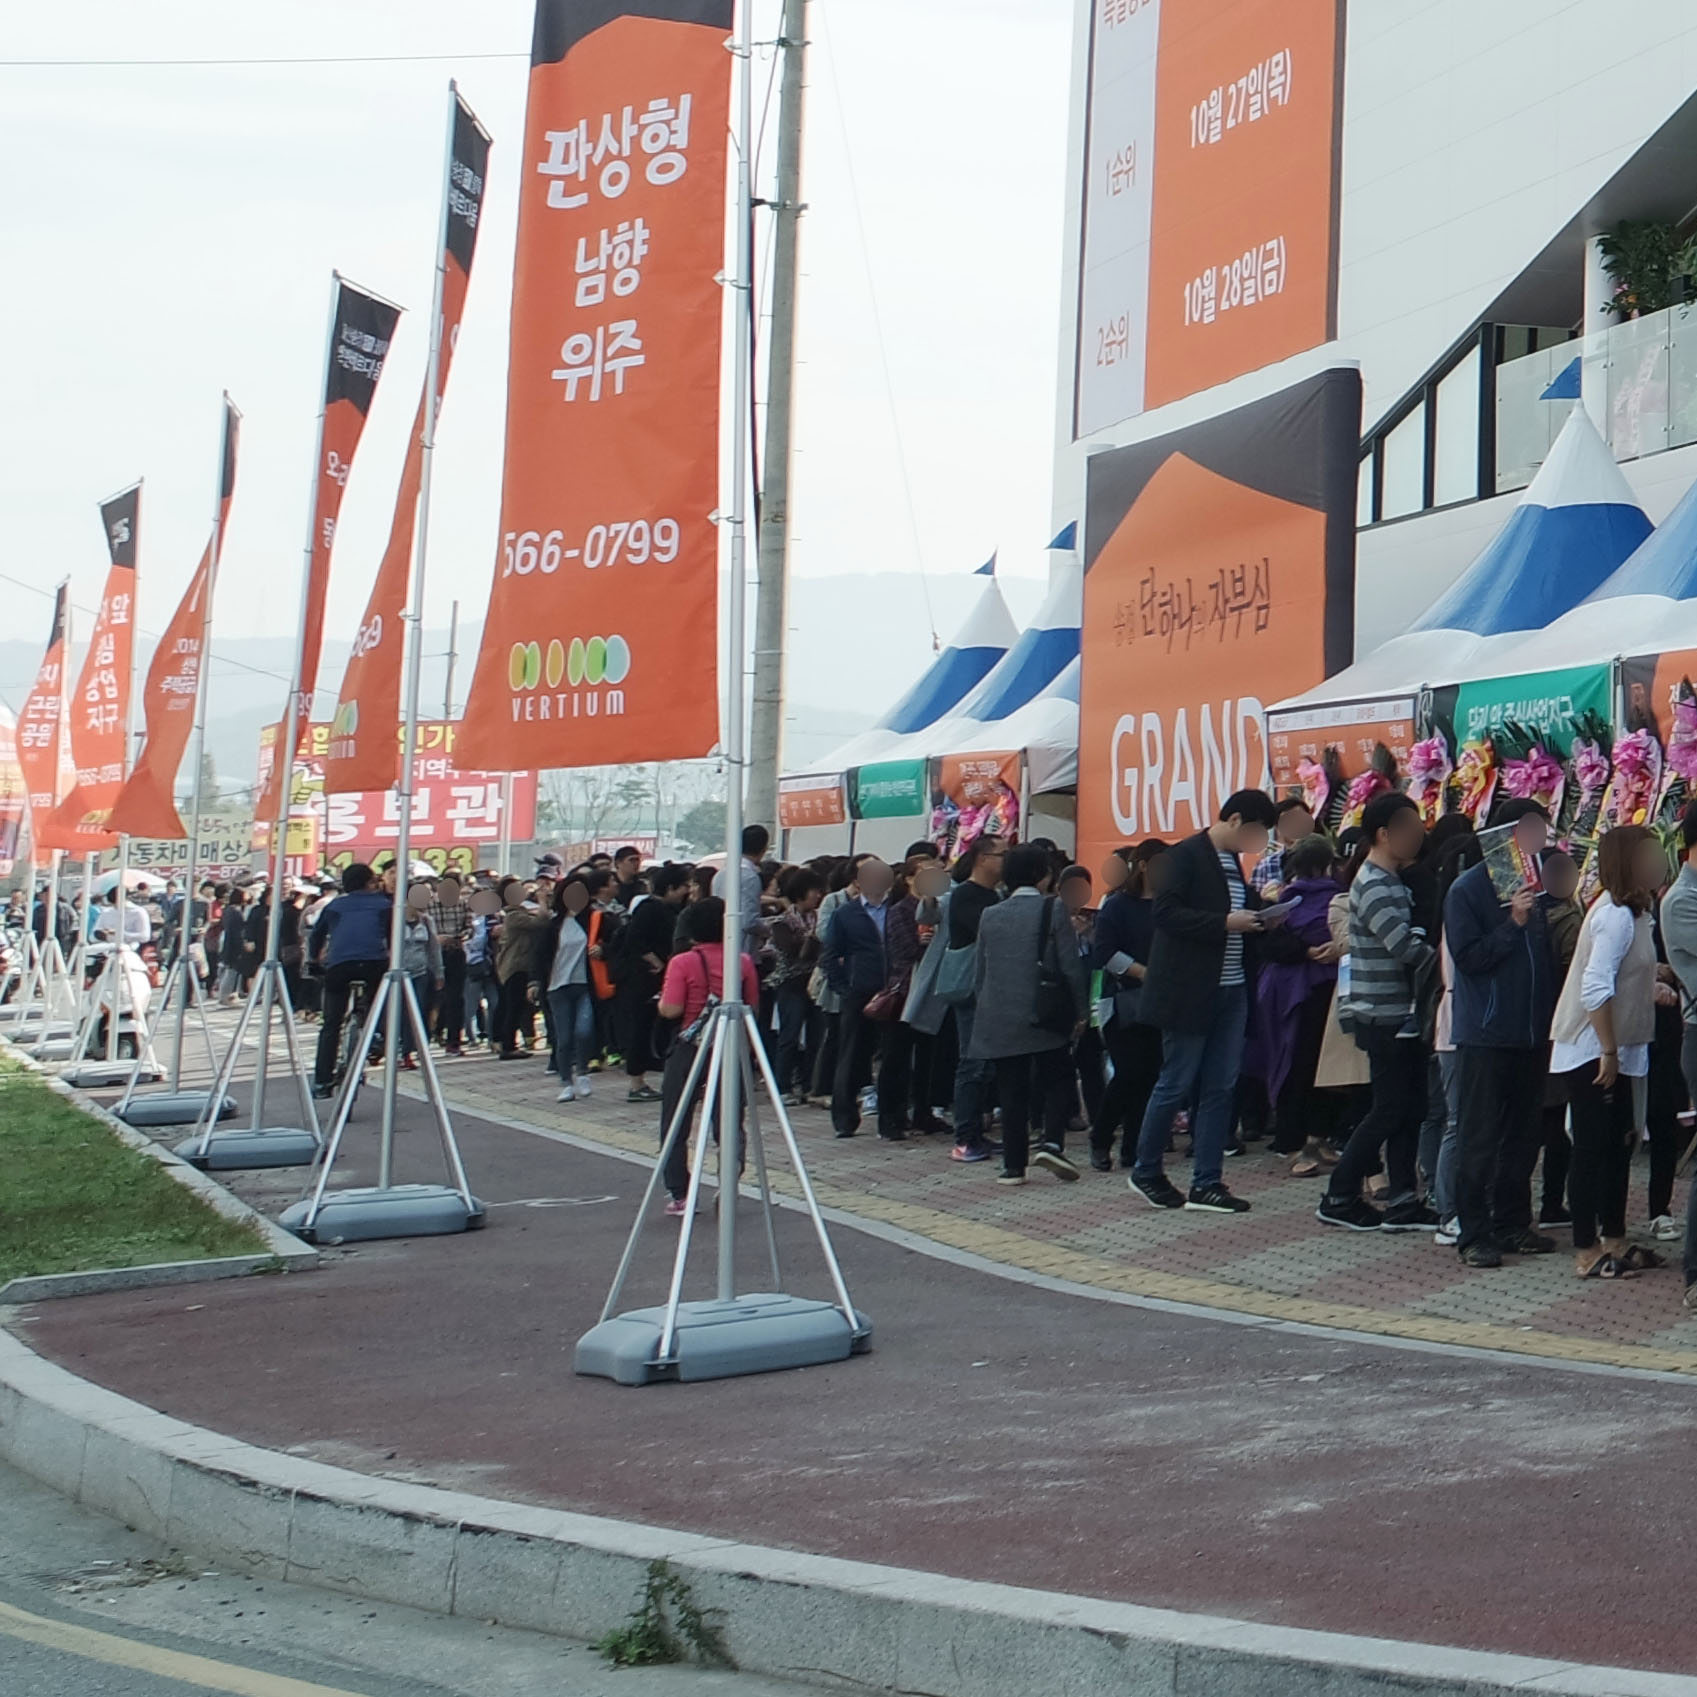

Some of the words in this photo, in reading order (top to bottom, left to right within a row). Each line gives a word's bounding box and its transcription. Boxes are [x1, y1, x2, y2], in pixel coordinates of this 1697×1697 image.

[1190, 85, 1223, 149] 10월
[1226, 47, 1292, 130] 27일(목)
[536, 92, 692, 209] 판상형
[1106, 139, 1137, 197] 1순위
[574, 216, 650, 308] 남향
[1183, 265, 1217, 326] 10월
[1219, 235, 1287, 312] 28일(금)
[550, 319, 646, 402] 위주
[1096, 309, 1130, 367] 2순위
[1208, 556, 1271, 643] 자부심
[511, 688, 625, 723] VERTIUM
[1110, 696, 1270, 836] GRAND
